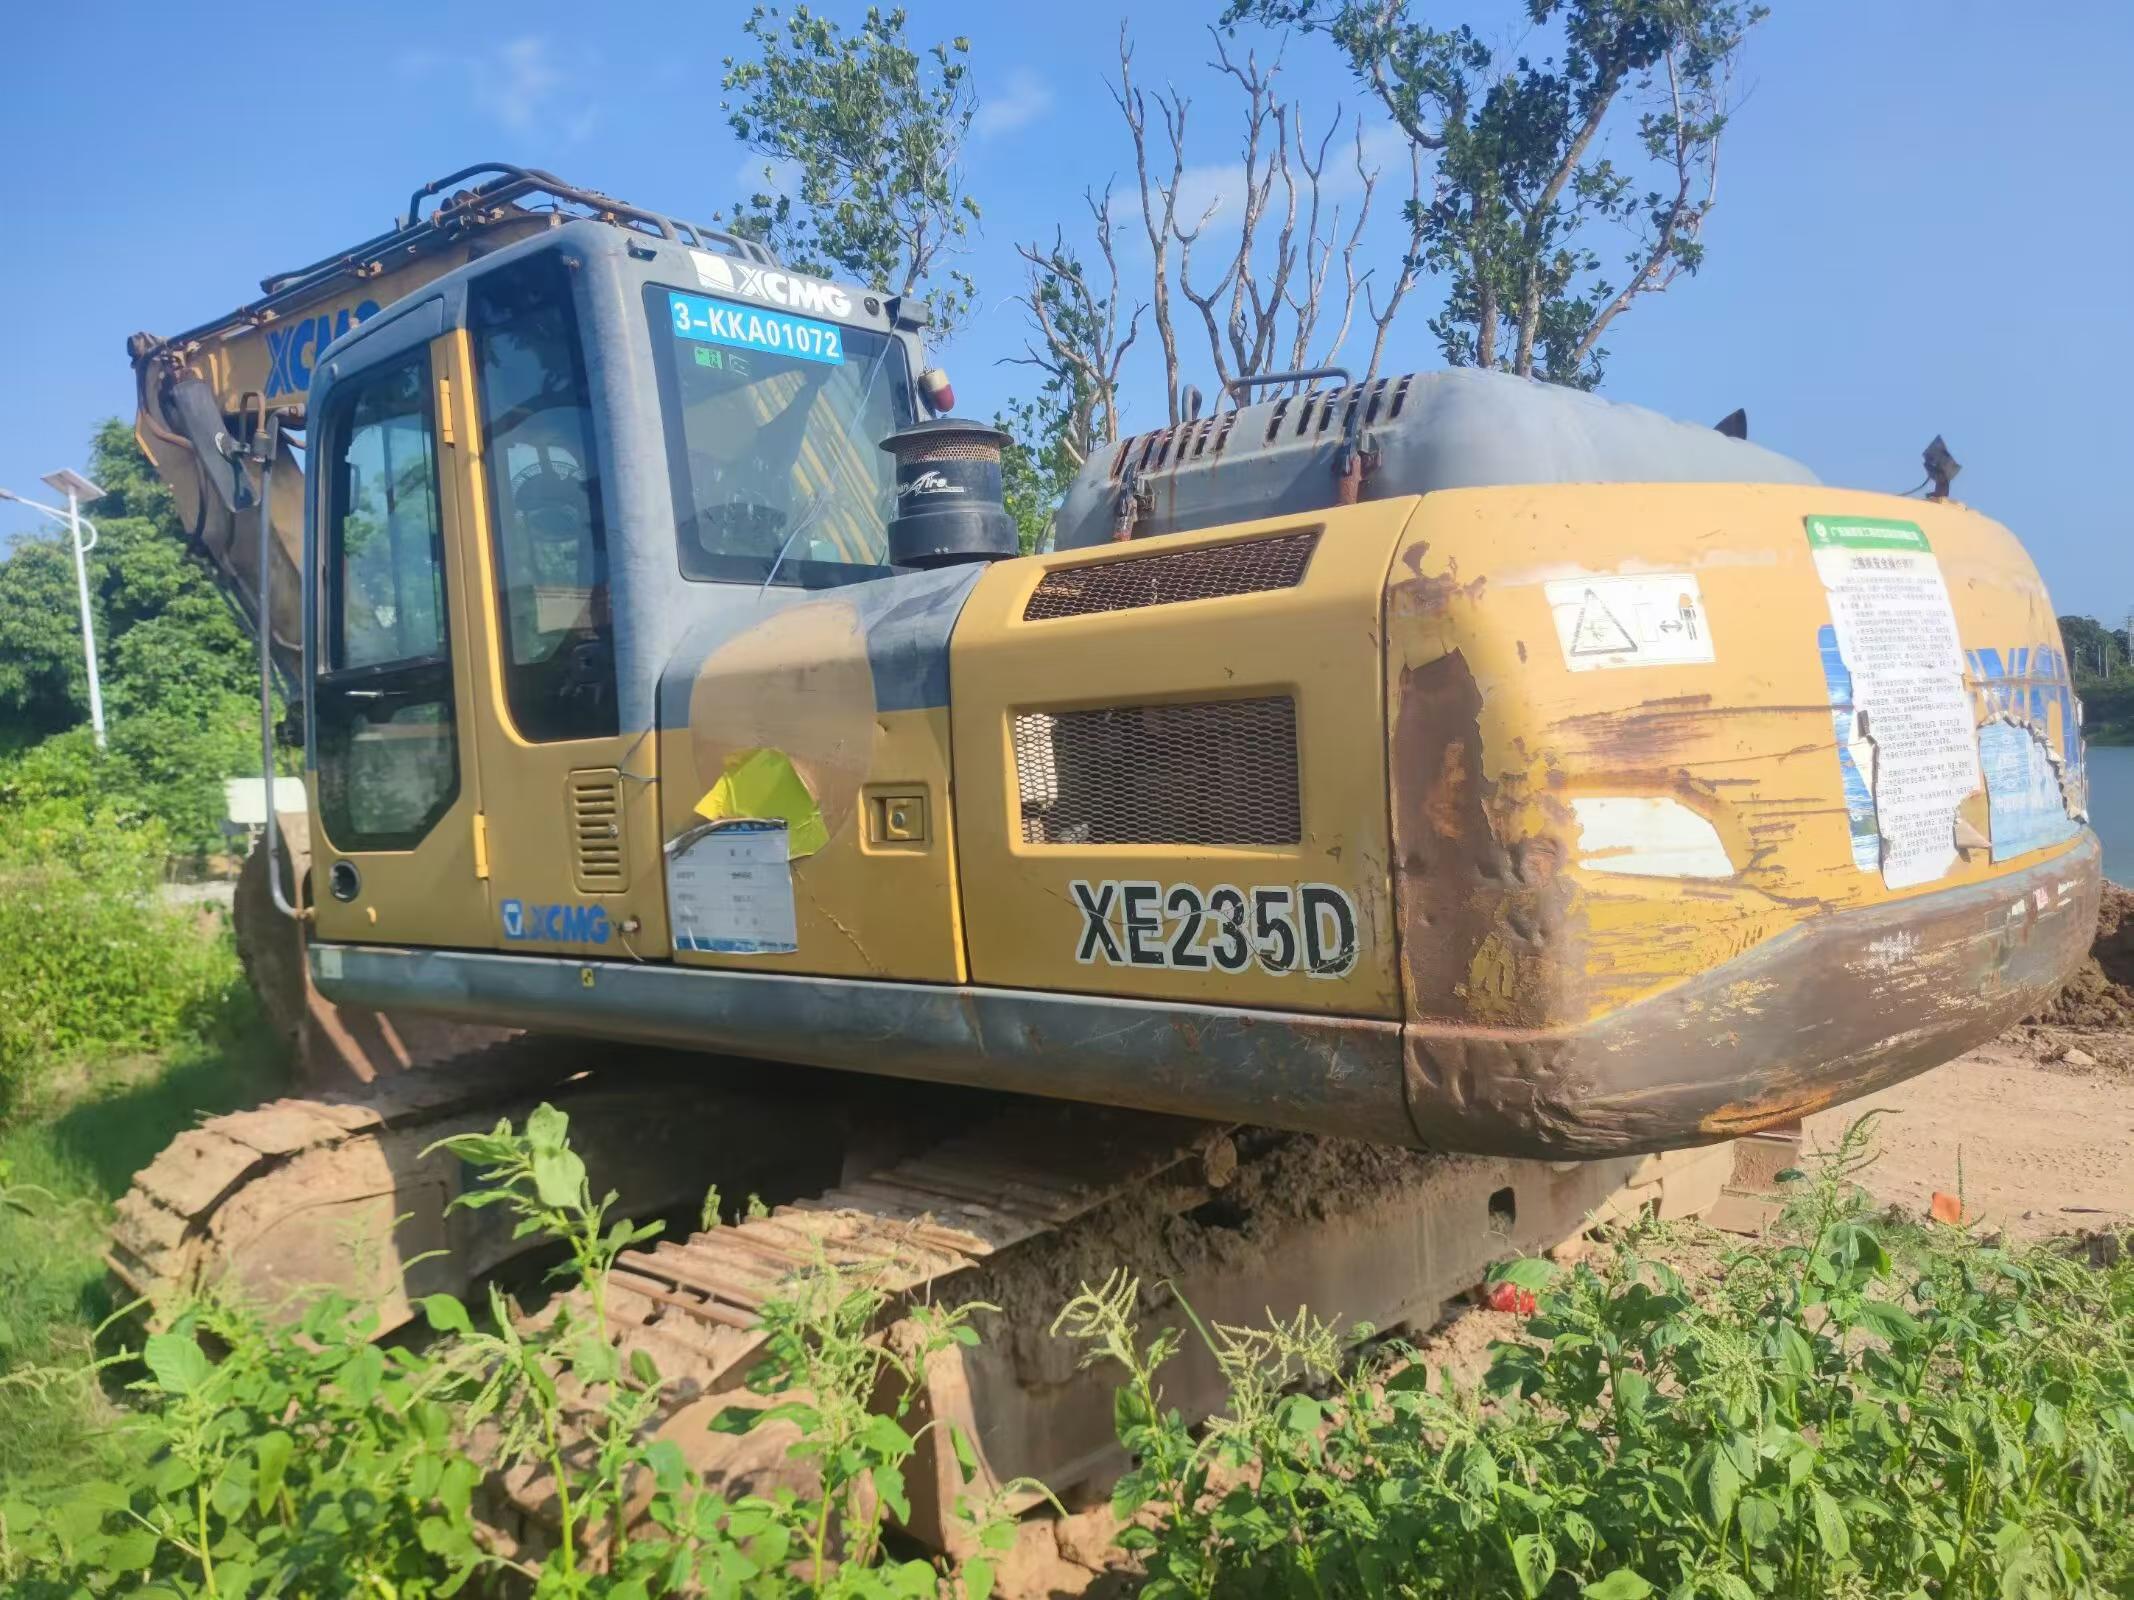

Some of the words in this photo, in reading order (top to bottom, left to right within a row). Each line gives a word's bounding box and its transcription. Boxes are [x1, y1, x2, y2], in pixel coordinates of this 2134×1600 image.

[733, 263, 852, 318] XCMG
[673, 302, 840, 359] 3-KKA01072
[526, 903, 611, 944] XCMG
[1069, 880, 1359, 979] XE235D
